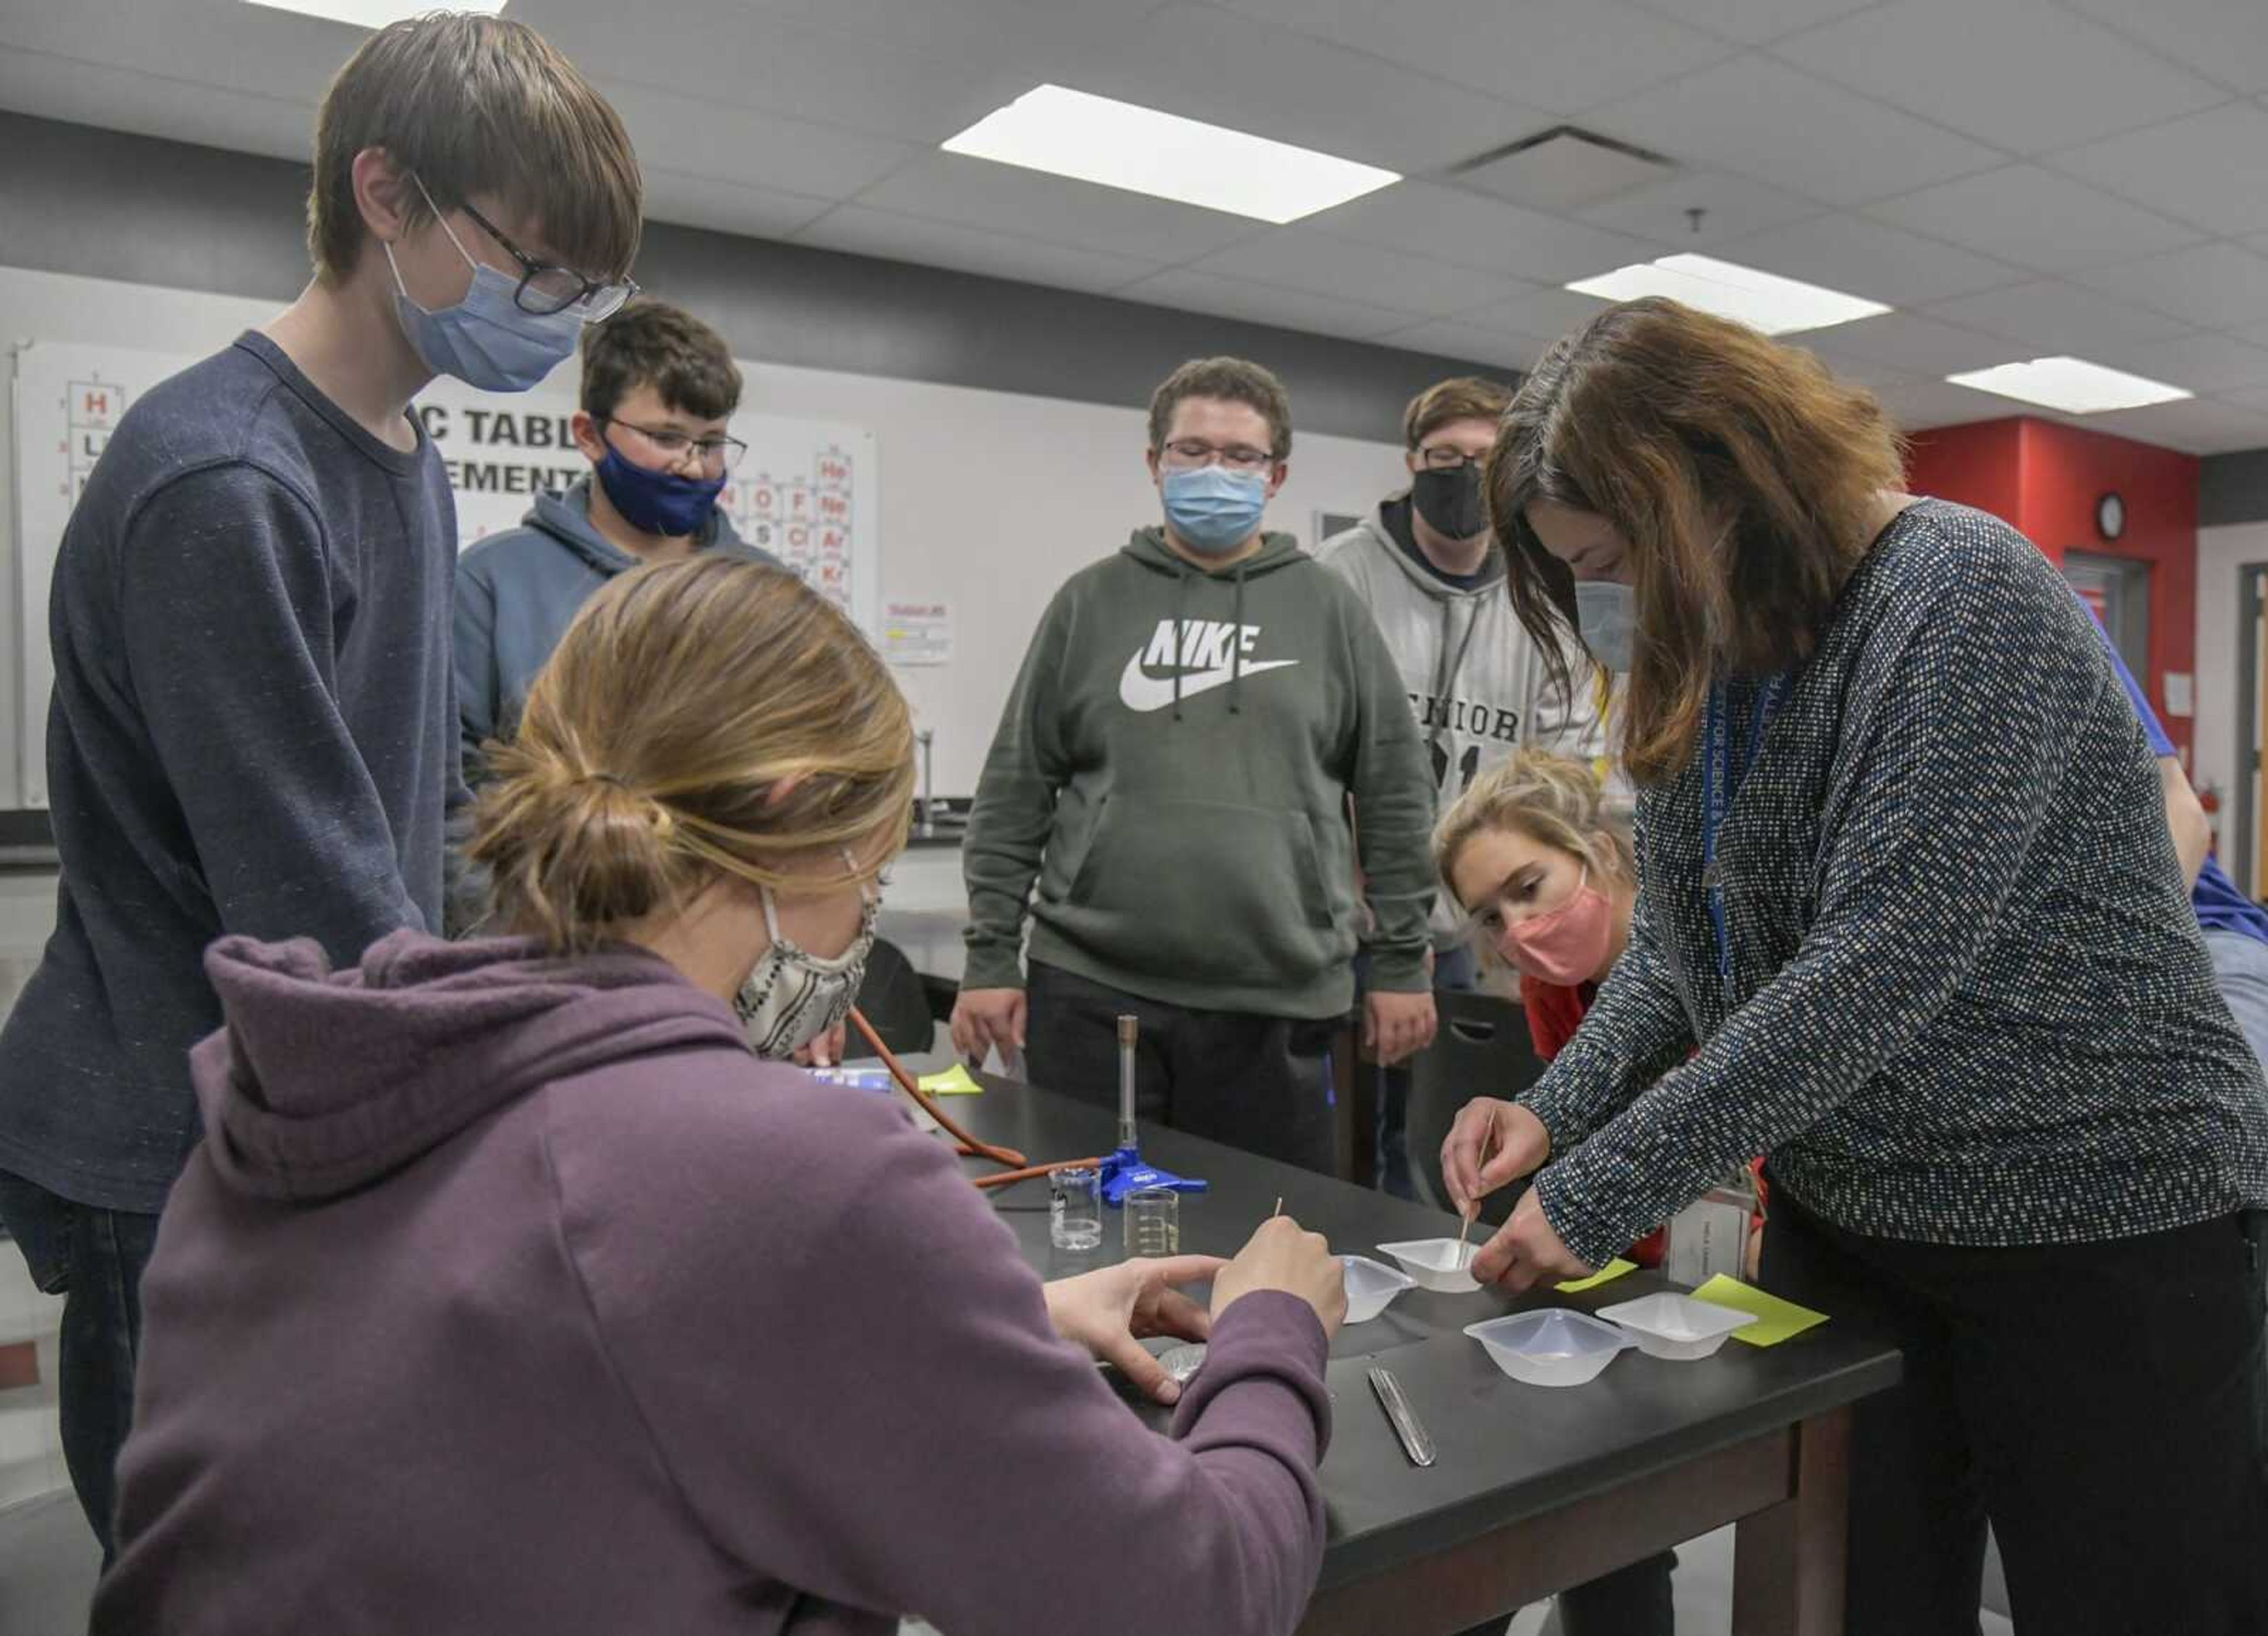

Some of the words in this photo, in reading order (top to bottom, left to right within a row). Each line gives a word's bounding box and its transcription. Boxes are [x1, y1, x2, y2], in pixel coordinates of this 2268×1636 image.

[84, 391, 107, 413] H
[463, 409, 584, 450] TABL
[1139, 618, 1262, 667] NIKE
[1409, 693, 1518, 744] NIOR
[1712, 748, 1725, 807] SCIENCE
